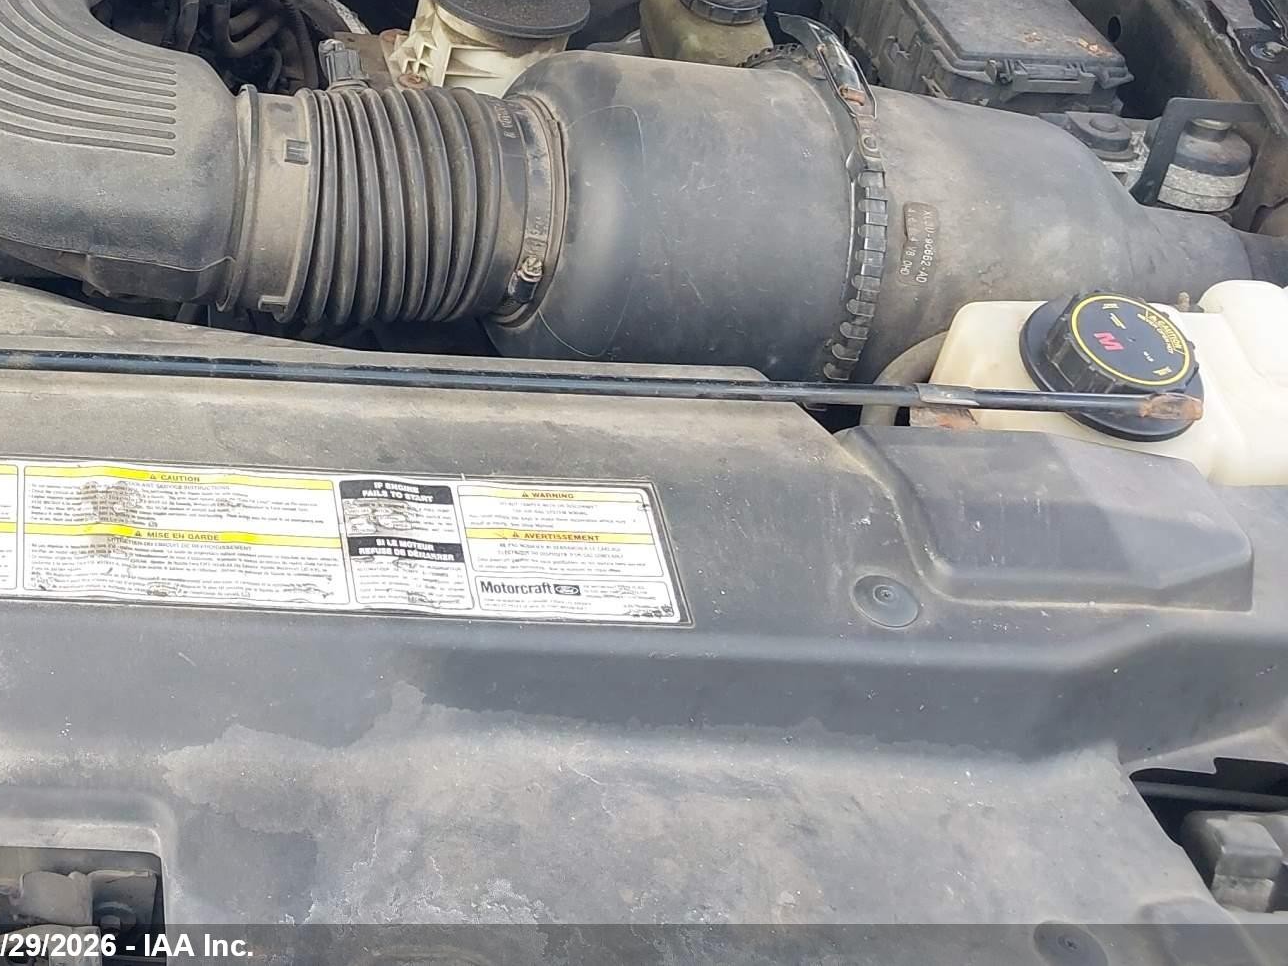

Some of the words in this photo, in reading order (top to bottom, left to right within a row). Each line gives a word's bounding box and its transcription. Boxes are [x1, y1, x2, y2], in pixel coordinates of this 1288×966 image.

[160, 474, 201, 483] CAUTION
[361, 489, 388, 498] FAILS
[390, 490, 403, 499] TO
[403, 492, 433, 503] START
[146, 531, 170, 539] MISE
[172, 532, 185, 540] EN
[187, 533, 220, 541] GARDE
[524, 532, 600, 542] AVERTISSEMENT
[480, 580, 554, 595] Motorcraft
